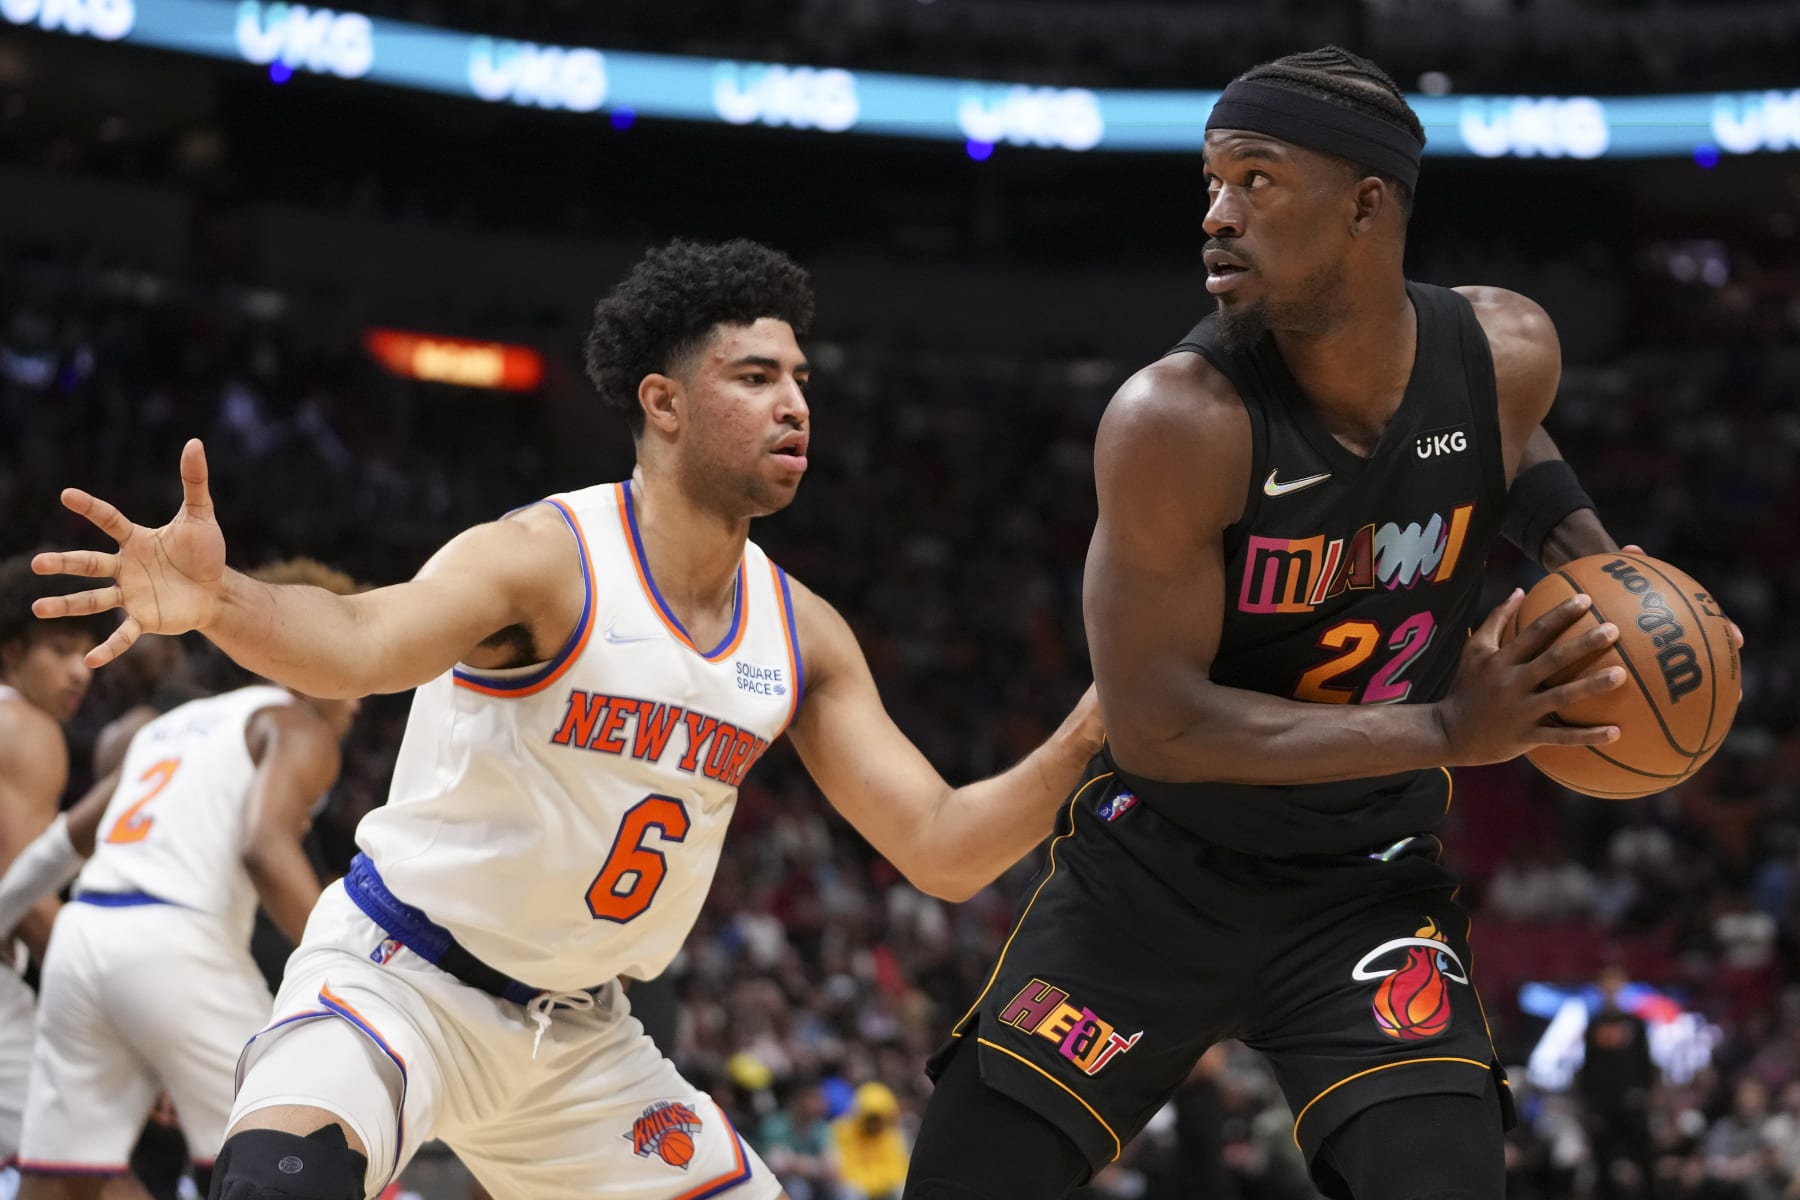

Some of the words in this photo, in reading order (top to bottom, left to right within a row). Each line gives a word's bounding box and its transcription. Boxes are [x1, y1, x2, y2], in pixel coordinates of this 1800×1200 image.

[736, 661, 782, 681] SQUARE
[737, 676, 772, 695] SPACE
[1292, 610, 1437, 705] 22
[551, 690, 683, 762] NEW
[105, 755, 181, 844] 2
[585, 793, 691, 924] 6
[633, 1102, 703, 1155] KNICKS
